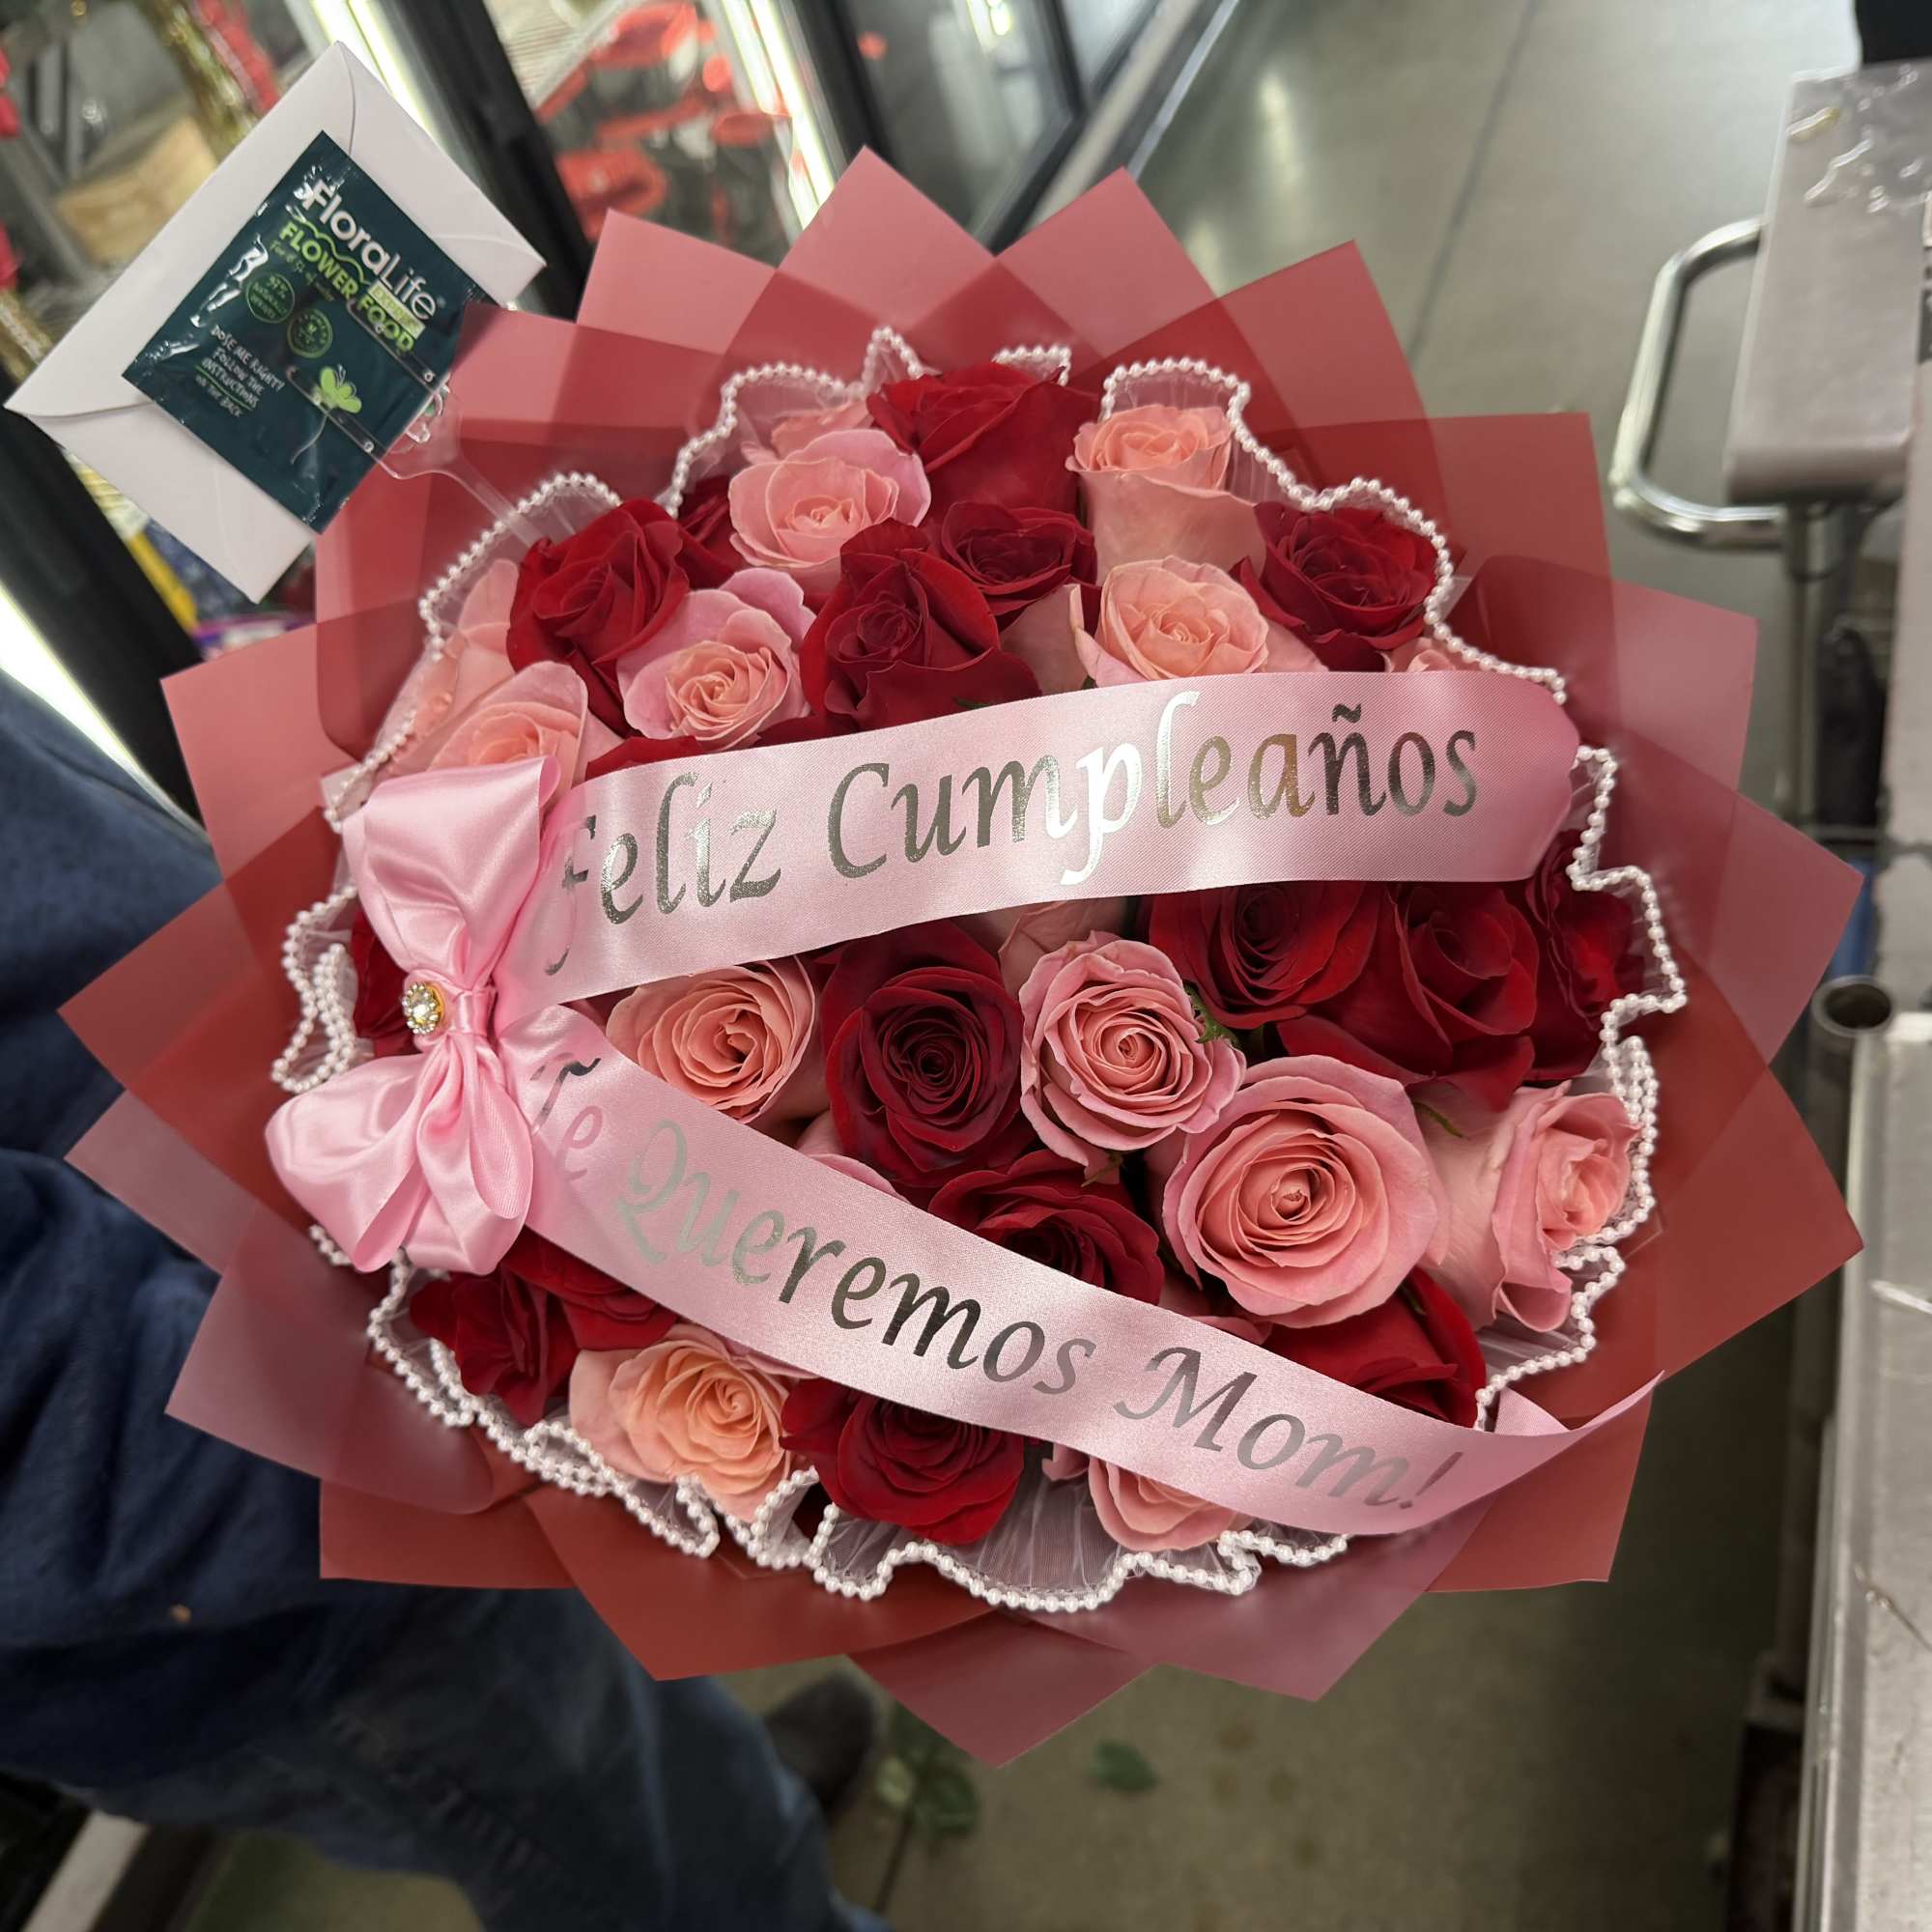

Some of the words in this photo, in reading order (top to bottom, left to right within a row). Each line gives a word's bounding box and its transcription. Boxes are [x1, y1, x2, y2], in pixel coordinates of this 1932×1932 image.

[279, 221, 358, 300] FLOWER
[358, 295, 414, 352] FOOD
[301, 180, 437, 320] FloraLife
[211, 325, 234, 351] DOSE
[233, 345, 252, 366] ME
[212, 346, 249, 383] FOLLOW
[246, 374, 266, 397] THE
[827, 691, 1477, 886] Cumpleaños
[610, 1118, 1097, 1395] Queremos
[1113, 1347, 1463, 1509] Mom!
